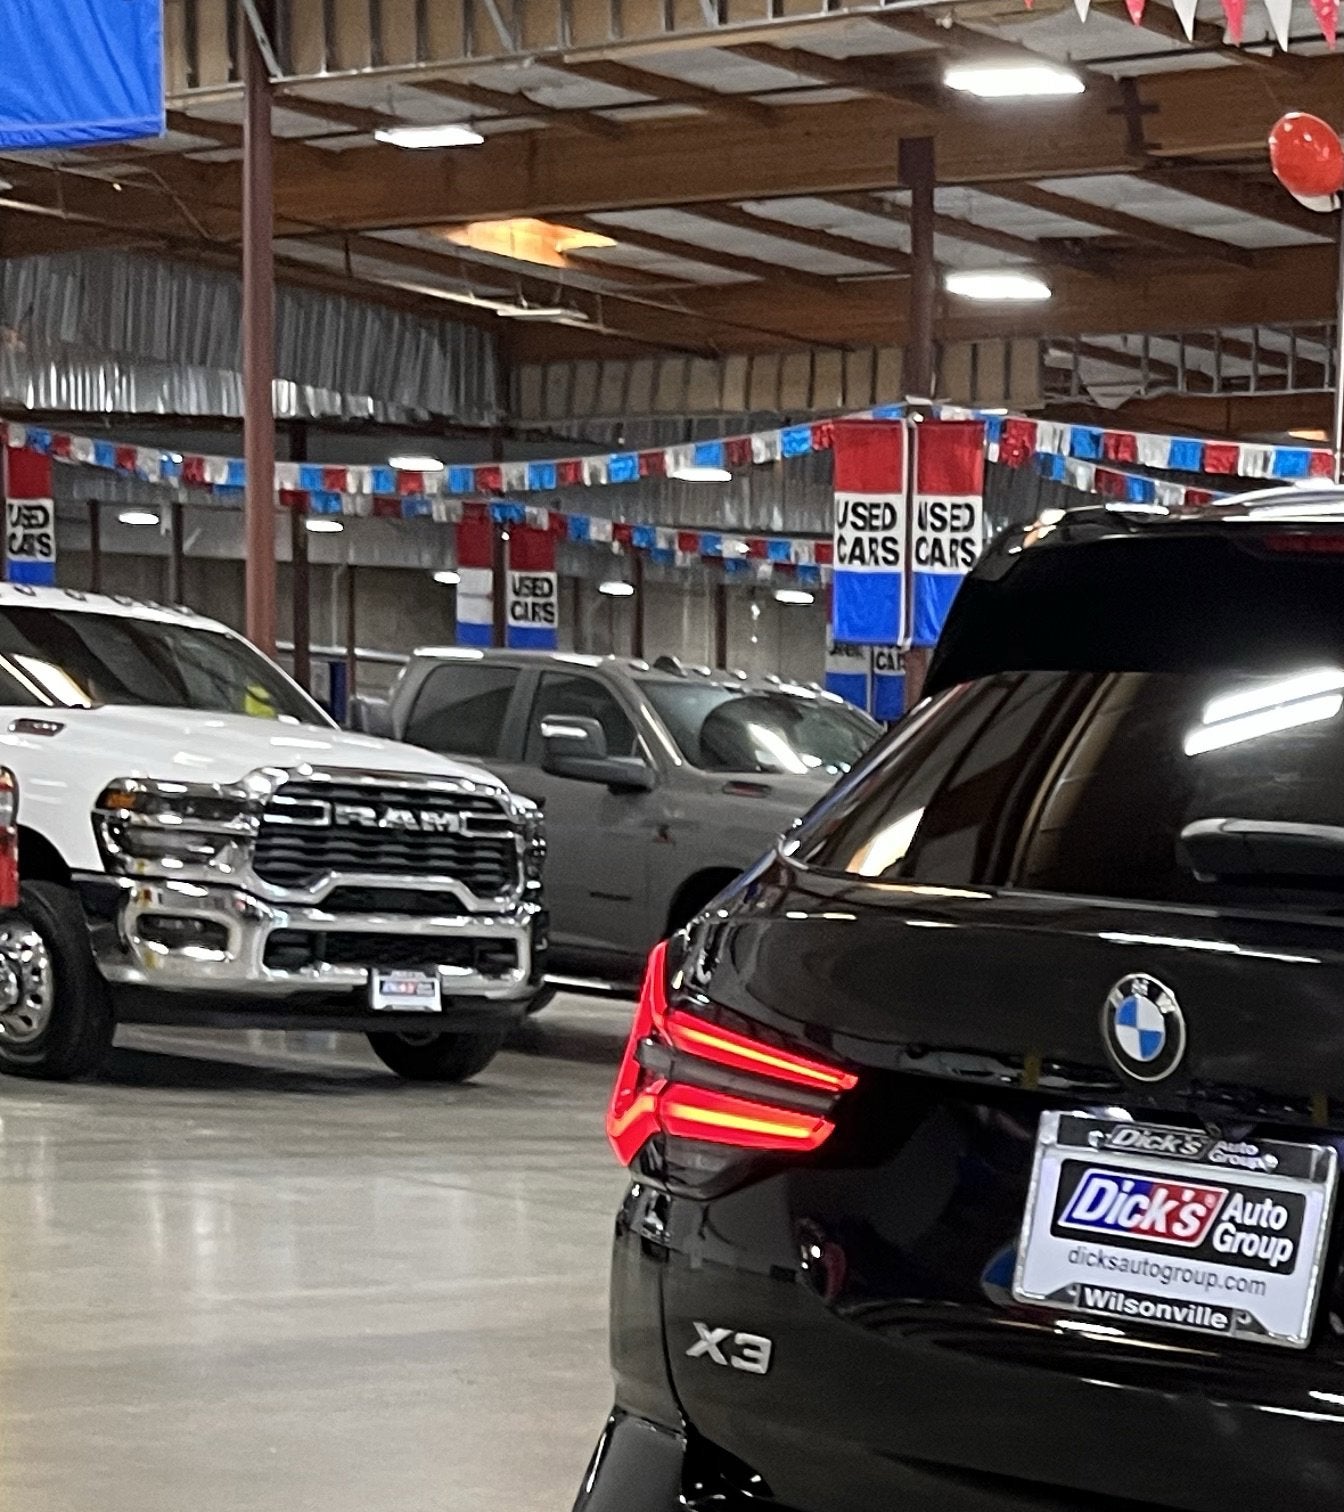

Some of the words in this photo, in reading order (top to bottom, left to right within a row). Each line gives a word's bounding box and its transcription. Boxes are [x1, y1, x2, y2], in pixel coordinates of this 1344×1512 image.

[837, 500, 898, 532] USED
[918, 501, 975, 533] USED
[837, 534, 900, 566] CARS
[915, 536, 976, 567] CARS
[512, 576, 553, 598] USED
[876, 651, 905, 671] CAR
[335, 802, 459, 832] RAM
[1111, 1128, 1203, 1156] Dick's
[1071, 1172, 1207, 1237] Dick's
[1220, 1192, 1289, 1231] Auto
[1212, 1222, 1294, 1267] Group
[1067, 1246, 1268, 1297] dicksautogroup.com
[1083, 1287, 1229, 1329] Wilsonville
[685, 1321, 772, 1375] X3
